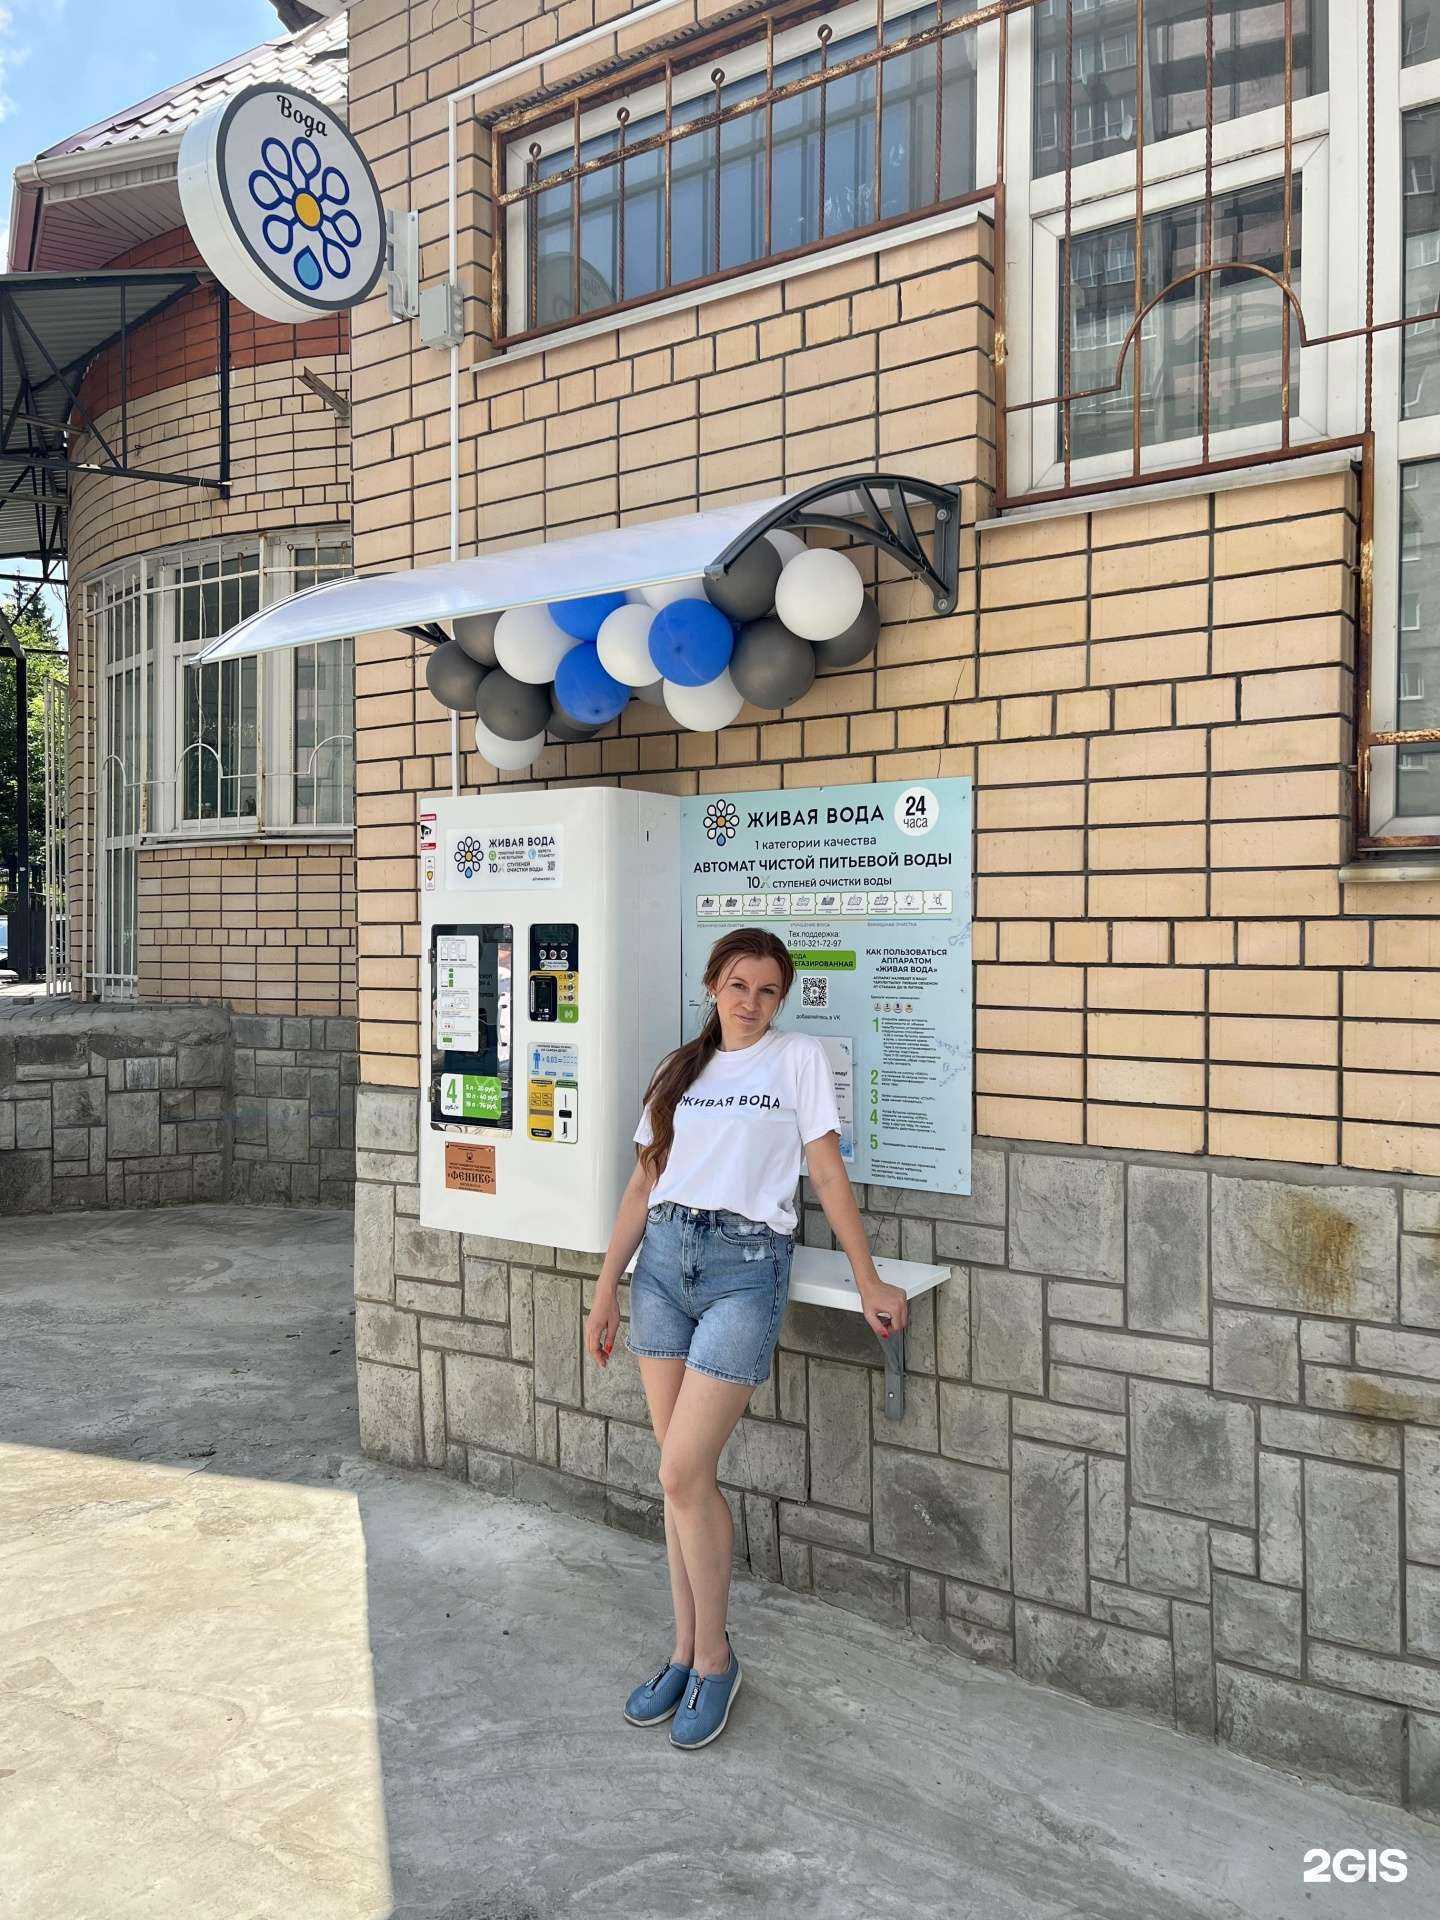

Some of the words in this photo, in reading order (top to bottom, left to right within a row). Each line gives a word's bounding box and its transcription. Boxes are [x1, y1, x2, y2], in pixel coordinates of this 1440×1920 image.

[277, 95, 328, 137] Вода
[905, 795, 927, 817] 24
[747, 808, 818, 829] ЖИВАЯ
[826, 804, 885, 825] ВОДА
[903, 817, 929, 829] часа
[489, 837, 524, 848] ЖИВАЯ
[527, 836, 555, 847] ВОДА
[755, 840, 759, 851] 1
[762, 839, 821, 851] категории
[823, 836, 877, 848] качества
[488, 863, 498, 873] 10
[693, 860, 756, 873] АВТОМАТ
[759, 855, 815, 871] ЧИСТОЙ
[819, 851, 899, 868] ПИТЬЕВОЙ
[903, 852, 952, 867] ВОДЫ
[747, 876, 760, 889] 10
[772, 878, 817, 889] СТУПЕНЕЙ
[819, 877, 861, 887] ОЧИСТКИ
[863, 877, 892, 887] ВОДЫ
[866, 948, 882, 956] КАК
[883, 948, 948, 956] ПОЛЬЗОВАТЬСЯ
[881, 957, 932, 965] АППАРАТОМ
[875, 965, 909, 973] «ЖИВАЯ
[910, 966, 938, 974] ВОДА»
[872, 1017, 879, 1033] 1
[870, 1069, 878, 1085] 2
[446, 1078, 458, 1104] 4
[870, 1088, 878, 1105] 3
[680, 1095, 735, 1108] ЖИВАЯ
[739, 1094, 781, 1110] ВОДА
[870, 1108, 879, 1125] 4
[870, 1134, 878, 1150] 5
